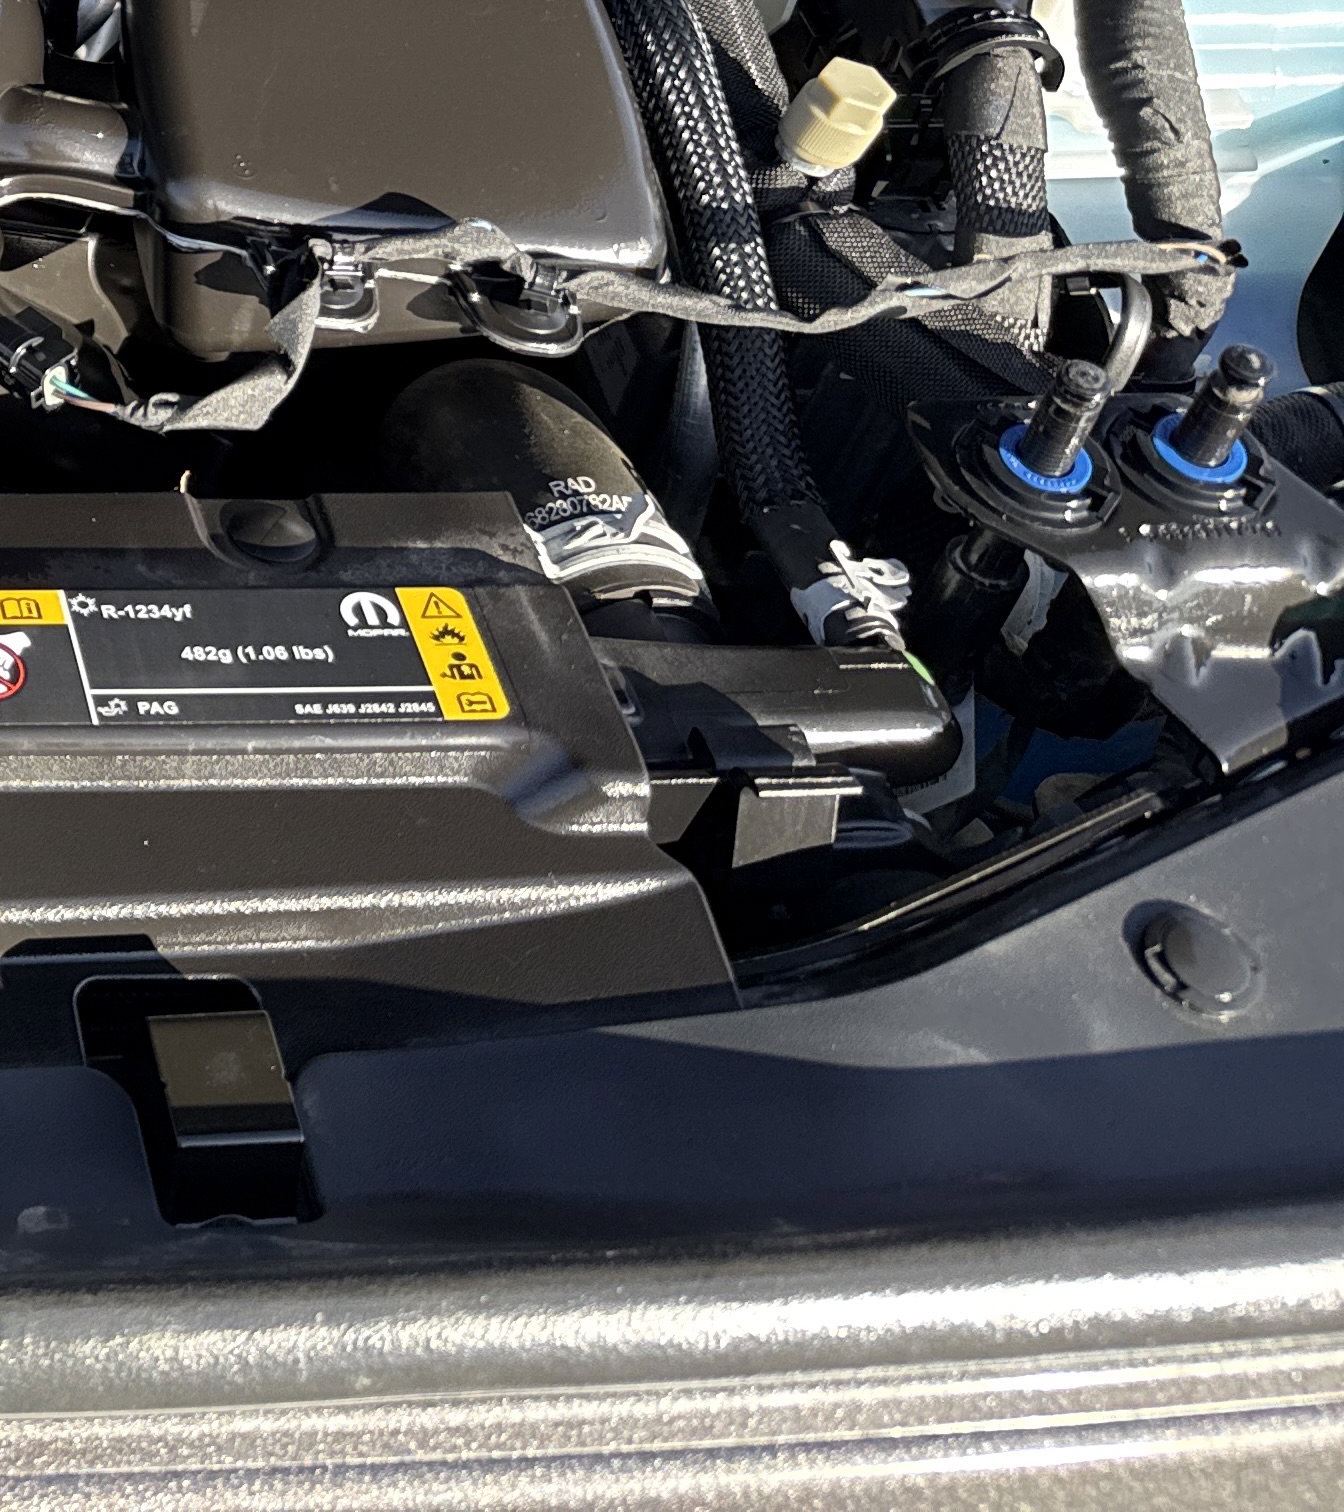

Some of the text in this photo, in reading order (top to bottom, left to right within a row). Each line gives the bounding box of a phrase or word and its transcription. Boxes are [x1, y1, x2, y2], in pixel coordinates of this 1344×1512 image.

[548, 476, 596, 497] RAD
[100, 604, 192, 621] R-1234yf
[181, 645, 334, 664] 482g (1.06 lbs)
[136, 700, 179, 715] PAG
[295, 703, 323, 715] SAE
